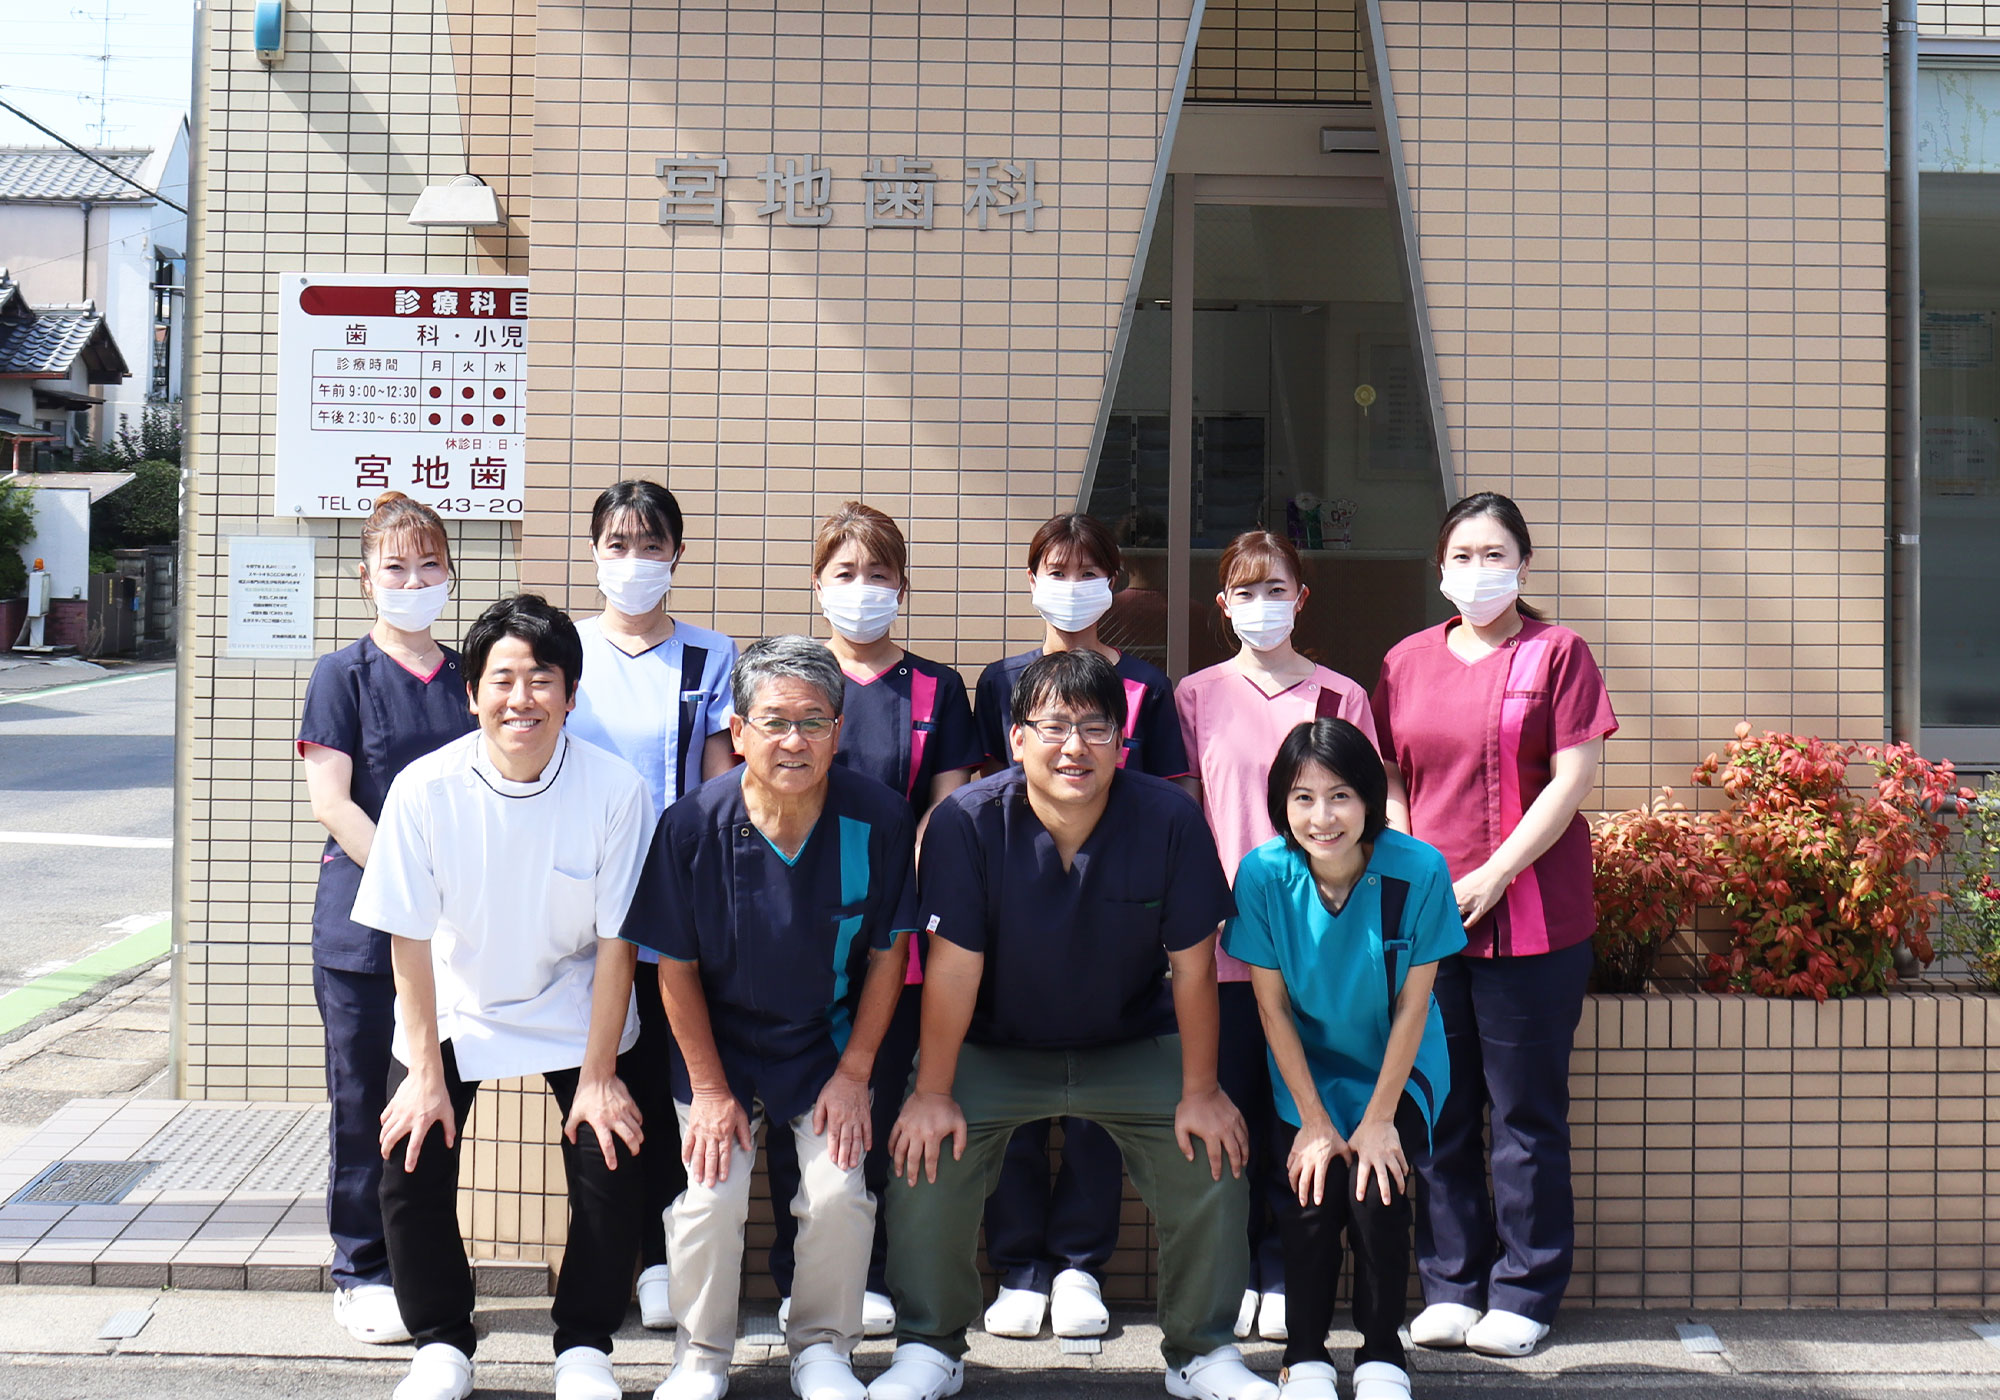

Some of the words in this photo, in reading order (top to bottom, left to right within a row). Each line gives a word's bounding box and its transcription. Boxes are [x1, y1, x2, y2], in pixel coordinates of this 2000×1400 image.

[656, 153, 1042, 232] 宮地歯科
[336, 357, 398, 372] 診療時間
[431, 360, 442, 372] 月
[463, 361, 474, 373] 火
[495, 361, 506, 373] 水
[319, 383, 345, 398] 午前
[318, 410, 344, 425] 午後
[390, 411, 417, 425] 6:30
[355, 454, 508, 491] 宮地歯
[318, 495, 351, 511] TEL
